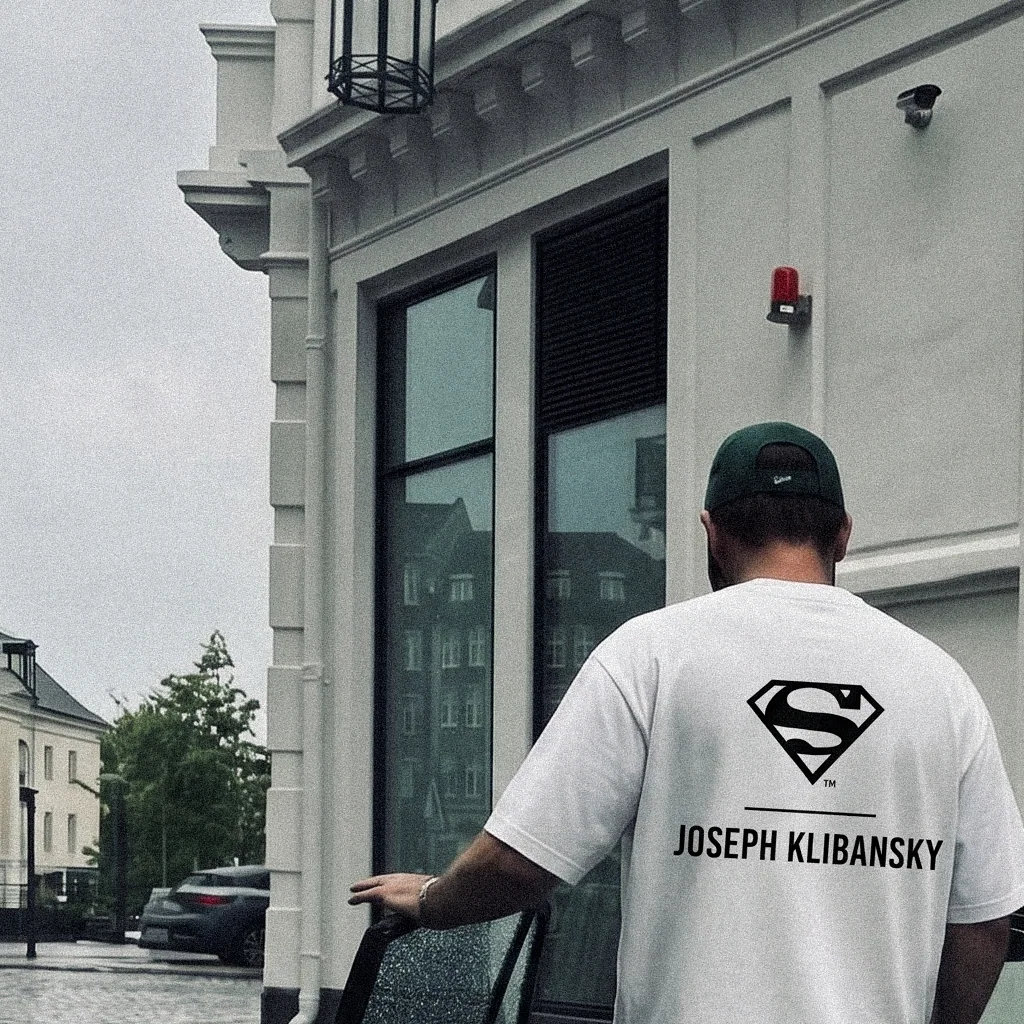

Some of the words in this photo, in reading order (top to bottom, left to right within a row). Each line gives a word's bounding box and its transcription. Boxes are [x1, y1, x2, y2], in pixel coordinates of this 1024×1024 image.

[823, 779, 837, 788] TM
[673, 824, 778, 861] JOSEPH
[787, 831, 944, 871] KLIBANSKY
